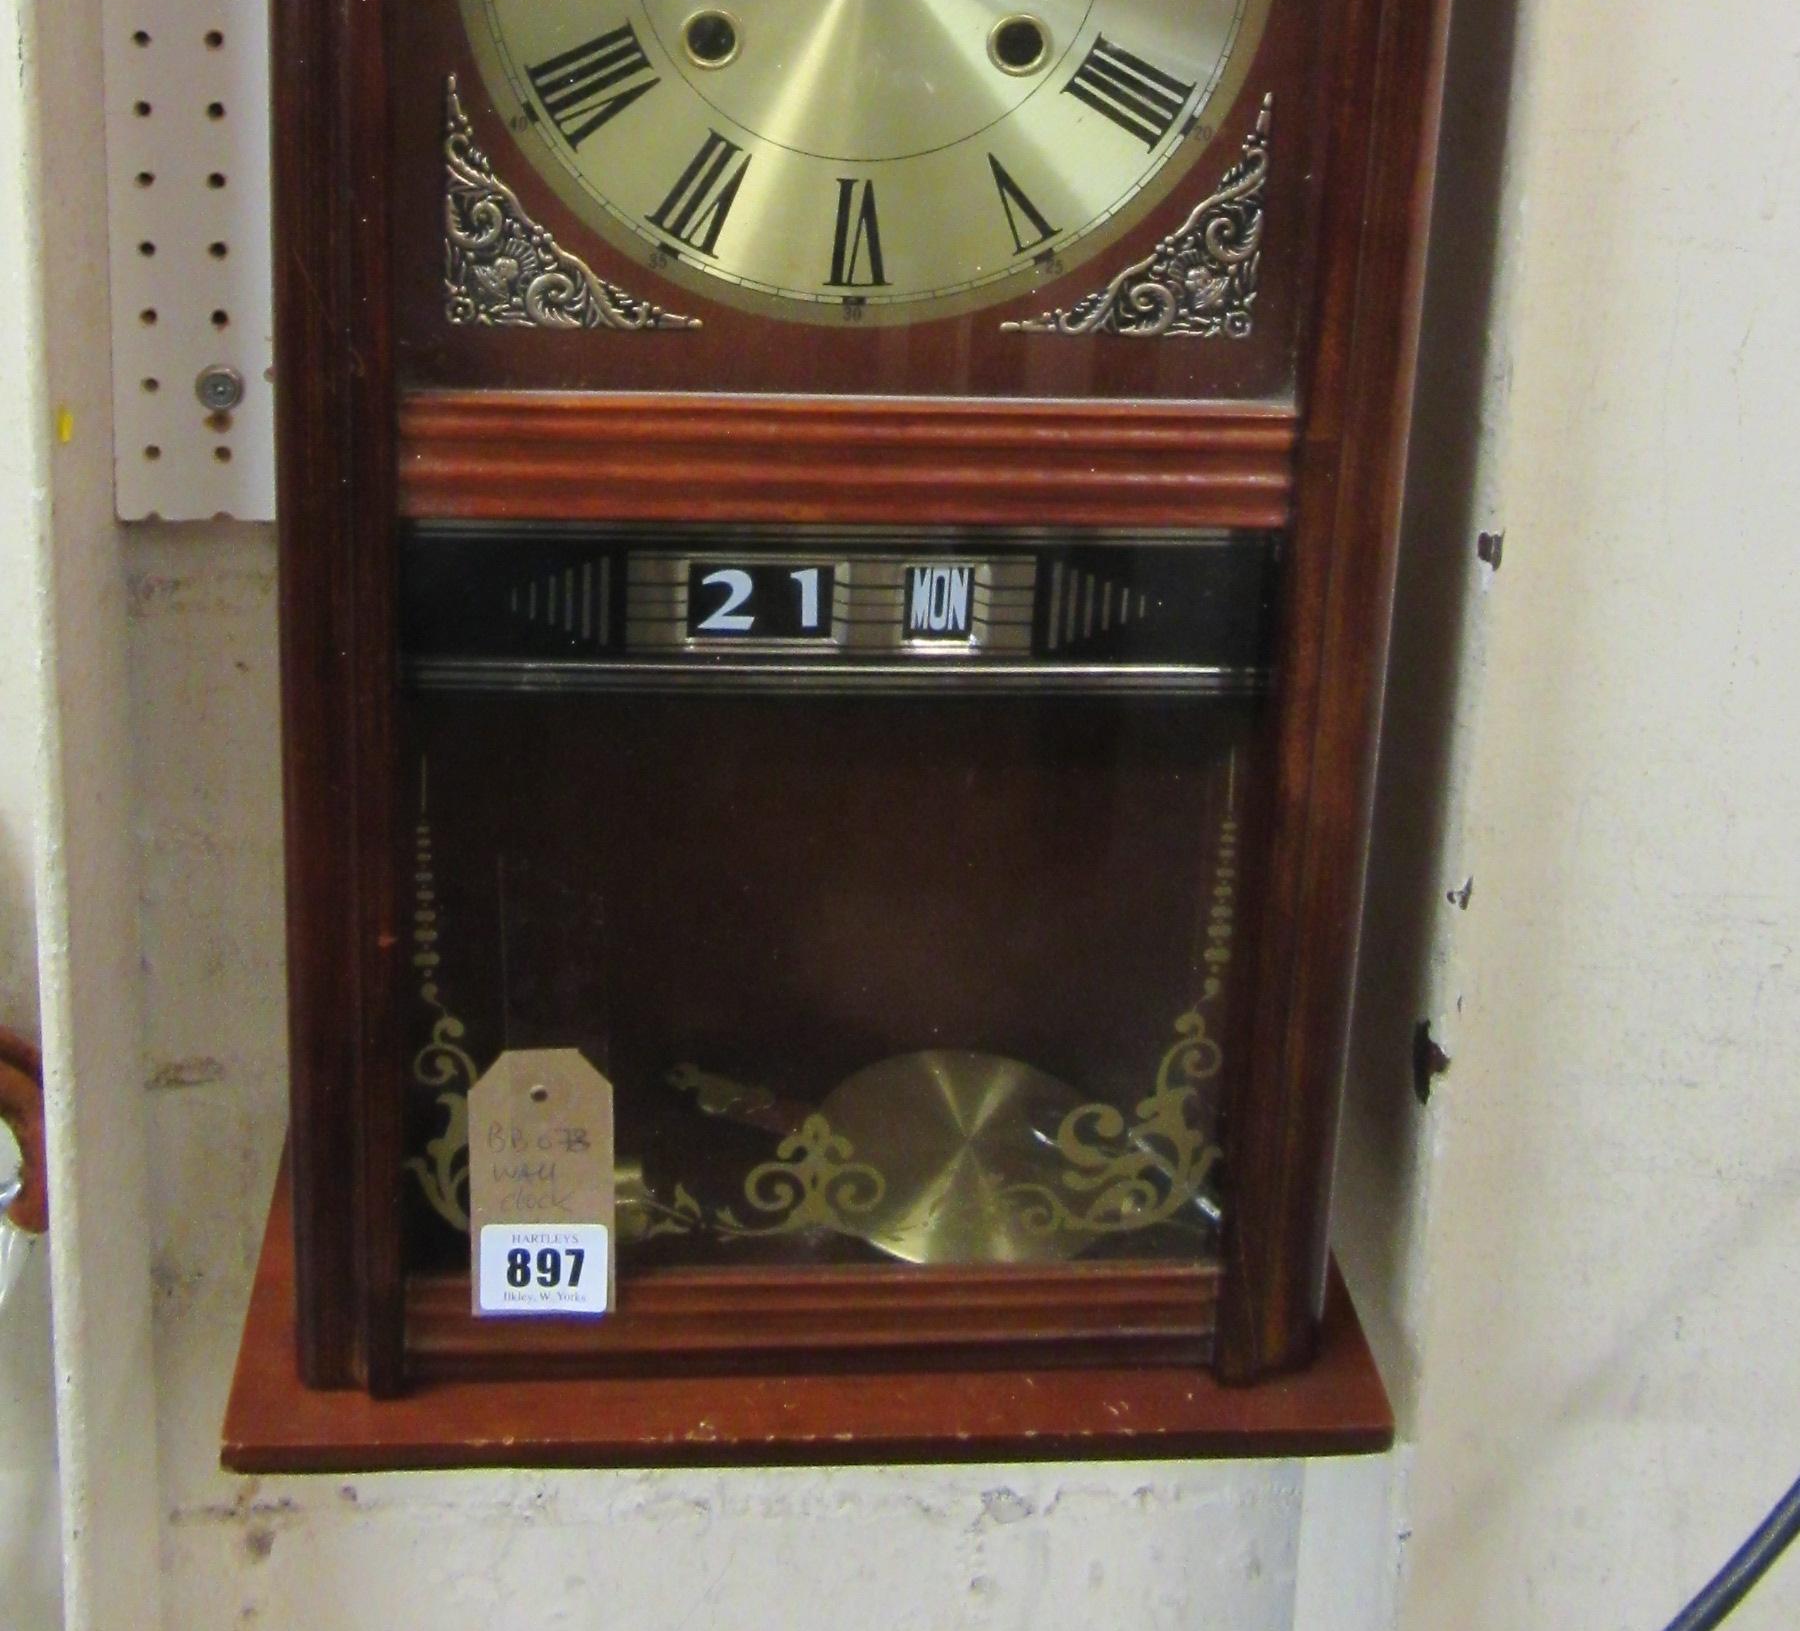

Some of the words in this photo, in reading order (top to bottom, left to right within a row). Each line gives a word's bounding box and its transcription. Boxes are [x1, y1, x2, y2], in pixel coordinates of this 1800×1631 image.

[524, 17, 661, 152] VIII
[510, 116, 528, 133] 40
[1195, 127, 1213, 142] 20
[644, 128, 753, 259] VII
[987, 152, 1063, 256] V
[822, 178, 892, 287] VI
[842, 305, 862, 322] 30
[697, 568, 818, 631] 21
[910, 566, 969, 631] MON
[511, 1232, 580, 1245] HARTLEYS
[506, 1247, 585, 1288] 897
